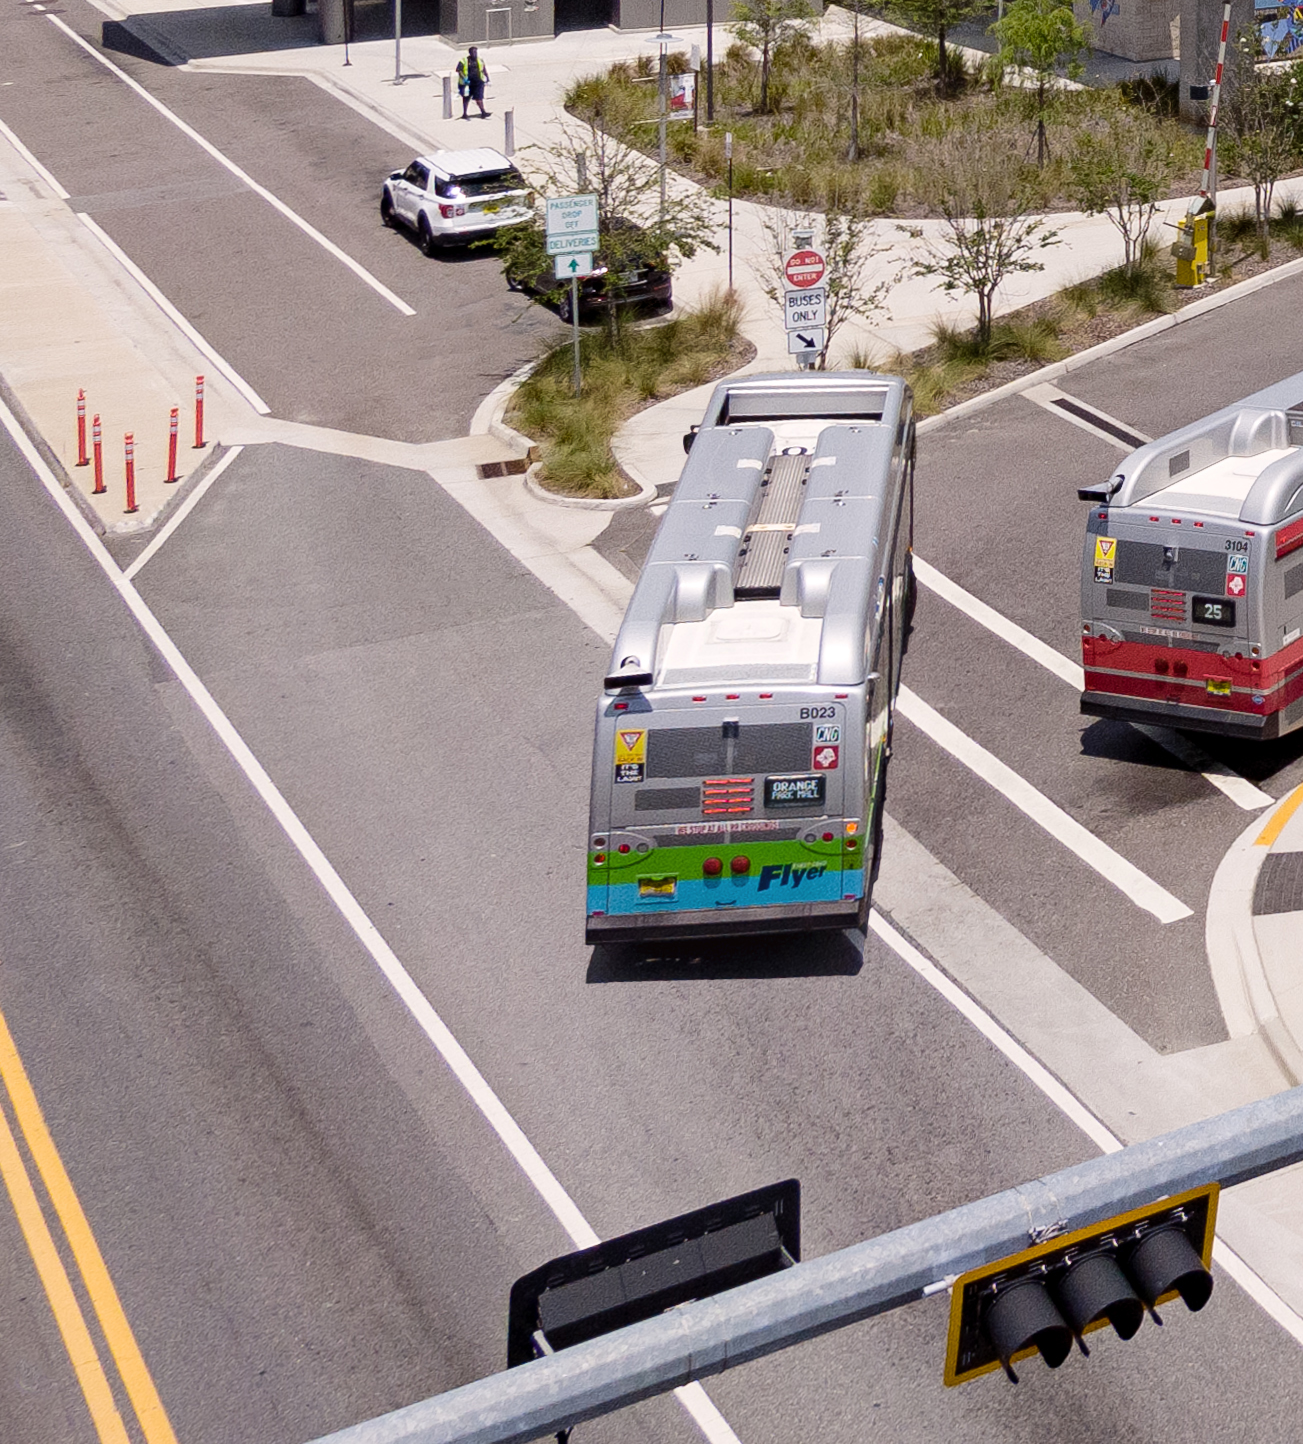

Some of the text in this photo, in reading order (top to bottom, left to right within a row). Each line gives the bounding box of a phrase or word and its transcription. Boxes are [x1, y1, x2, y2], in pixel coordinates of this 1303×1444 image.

[550, 199, 594, 210] PASSENGER
[550, 237, 596, 249] DELIVERIES
[790, 256, 819, 266] DO NOT
[793, 273, 818, 282] ENTER
[788, 294, 822, 307] BUSES
[792, 309, 818, 322] ONLY
[1225, 539, 1248, 553] 3104
[1229, 556, 1248, 572] CNG
[1204, 604, 1222, 619] 25
[800, 706, 836, 720] B023
[817, 726, 840, 743] CNG
[773, 779, 819, 791] ORANGE
[757, 862, 827, 892] Flyer
